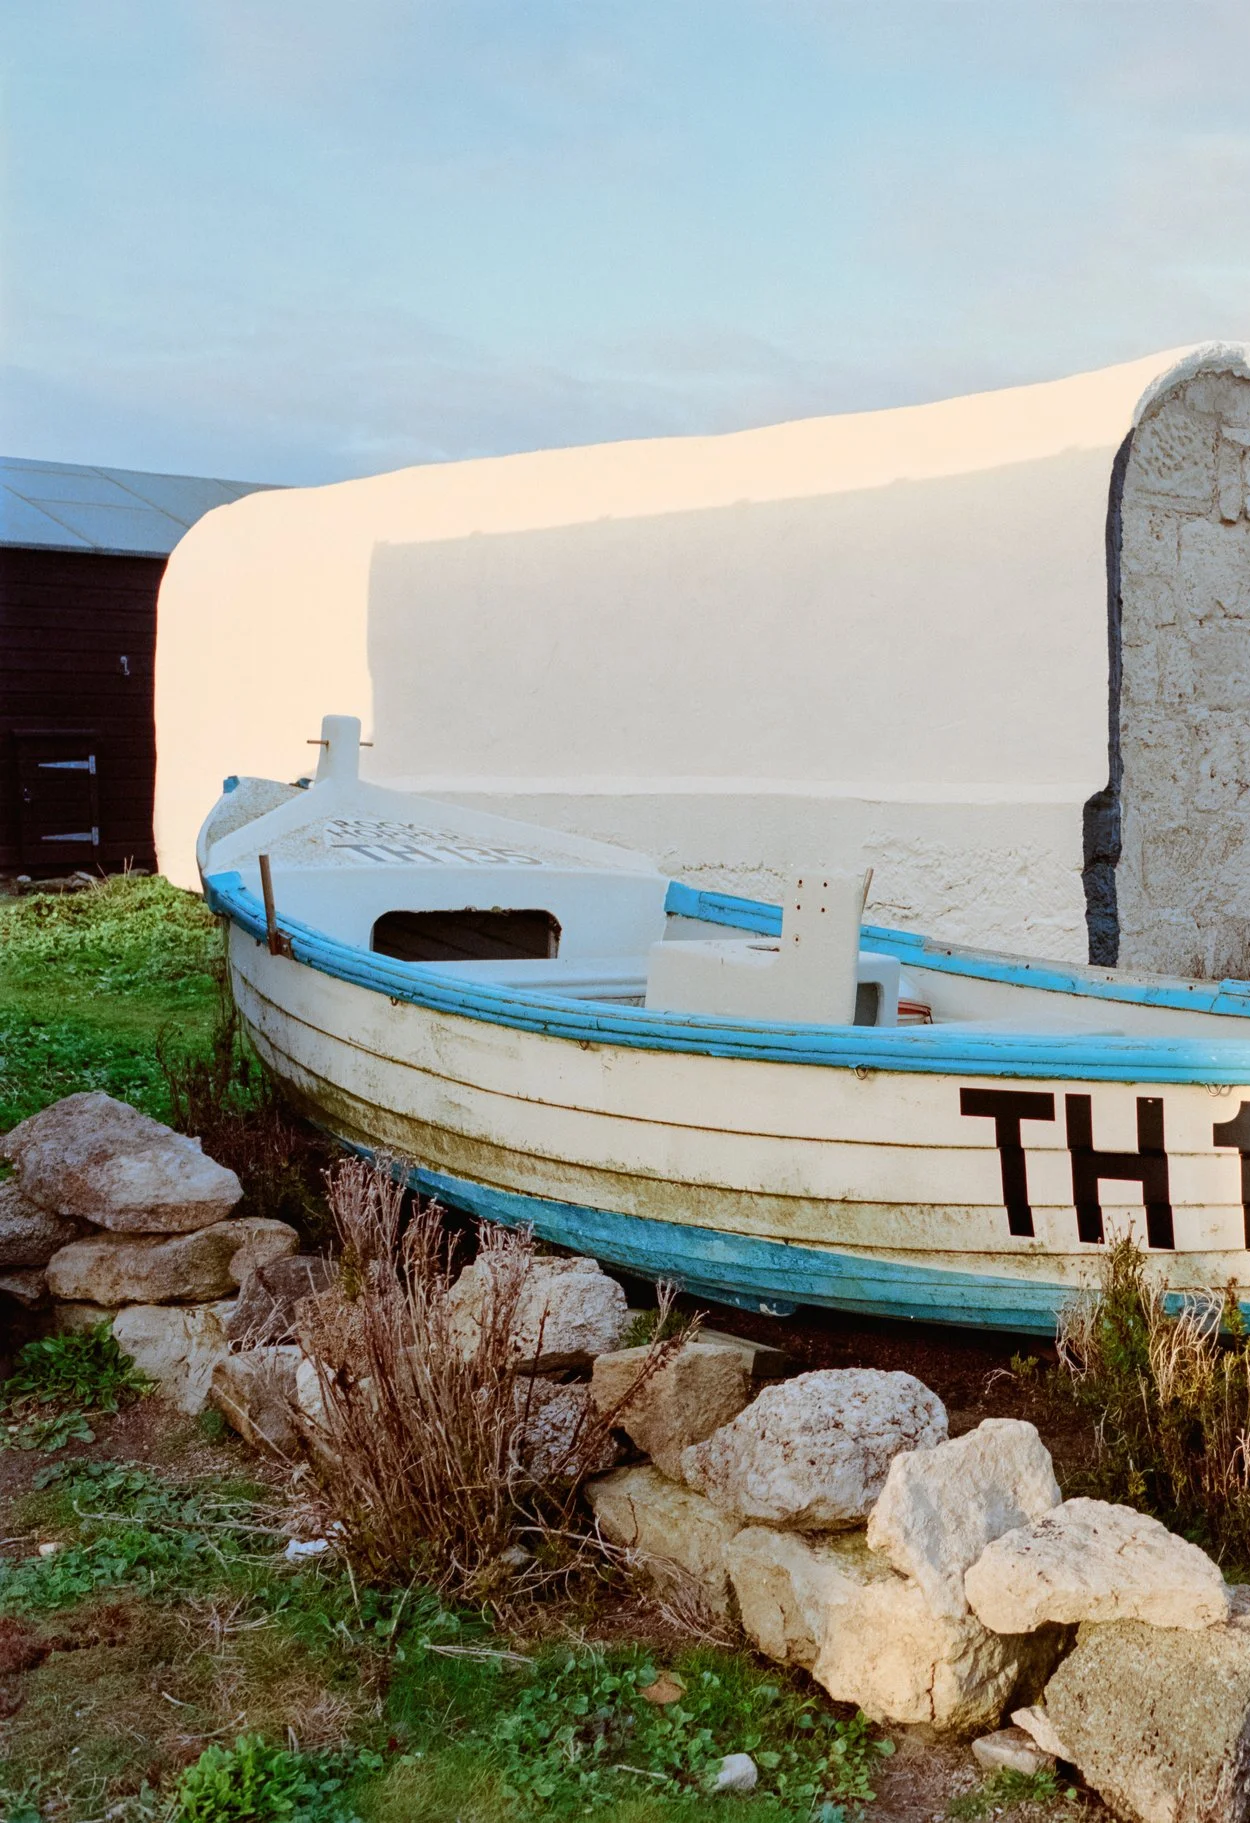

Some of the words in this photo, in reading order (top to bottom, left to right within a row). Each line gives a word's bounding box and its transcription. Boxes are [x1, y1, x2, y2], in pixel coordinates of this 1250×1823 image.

[331, 819, 415, 830] ROCK
[326, 829, 459, 841] HOPPER
[330, 844, 444, 864] TH
[434, 845, 543, 865] 135
[960, 1087, 1175, 1250] TH
